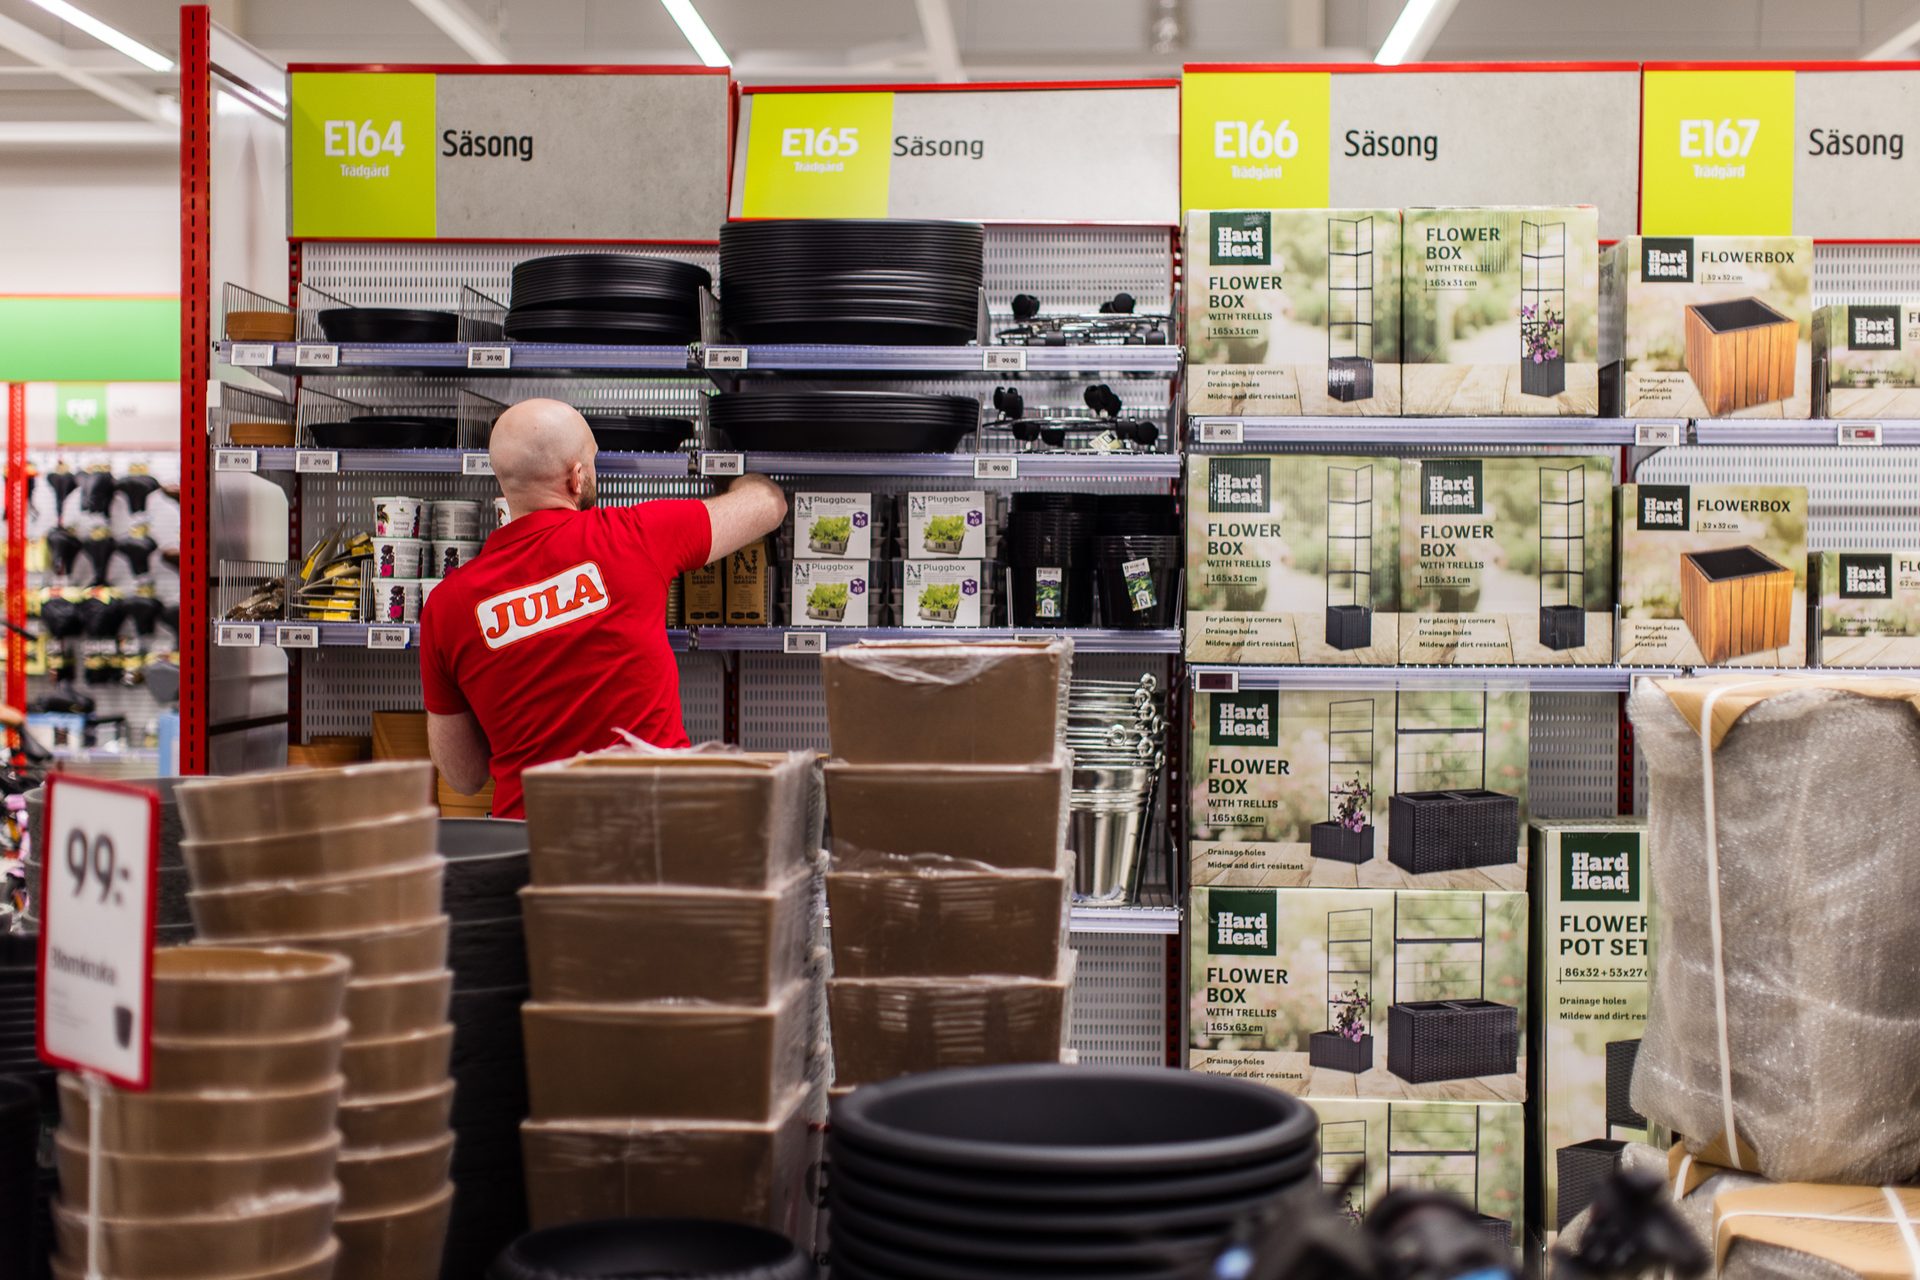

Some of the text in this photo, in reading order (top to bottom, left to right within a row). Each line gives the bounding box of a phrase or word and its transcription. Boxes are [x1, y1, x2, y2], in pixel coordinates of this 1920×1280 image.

[324, 120, 405, 157] E164
[442, 129, 533, 161] Säsong
[781, 127, 859, 157] E165
[1214, 120, 1299, 159] E166
[1344, 129, 1438, 161] Säsong
[1679, 119, 1760, 158] E167
[1808, 129, 1904, 160] Säsong
[893, 135, 984, 160] Säsong
[340, 163, 390, 179] Trädgård
[794, 160, 844, 174] Trädgård
[1231, 165, 1282, 181] Trädgård
[1693, 164, 1745, 180] Trädgård
[1218, 227, 1263, 242] Hard
[1426, 227, 1500, 241] FLOWER
[1218, 242, 1263, 257] Head
[1426, 246, 1462, 260] BOX
[1648, 250, 1687, 263] Hard
[1701, 251, 1795, 264] FLOWERBOX
[1425, 264, 1451, 272] WITH
[1648, 263, 1687, 276] Head
[1209, 276, 1283, 290] FLOWER
[1209, 294, 1245, 308] BOX
[1236, 312, 1273, 320] TRELLIS
[1855, 317, 1894, 331] Hard
[1855, 331, 1894, 344] Head
[1220, 369, 1247, 377] placing
[1217, 474, 1262, 488] Hard
[1429, 476, 1474, 491] Hard
[813, 496, 856, 505] Pluggbox
[927, 495, 970, 504] Pluggbox
[1217, 488, 1262, 504] Head
[1429, 491, 1474, 506] Head
[1645, 498, 1683, 511] Hard
[1697, 500, 1791, 512] FLOWERBOX
[1645, 511, 1683, 524] Head
[1208, 523, 1281, 537] FLOWER
[1421, 525, 1494, 539] FLOWER
[1208, 541, 1243, 555] BOX
[1421, 543, 1456, 557] BOX
[811, 563, 854, 571] Pluggbox
[923, 563, 966, 572] Pluggbox
[1207, 560, 1271, 568] WITH TRELLIS
[1420, 561, 1484, 569] WITH TRELLIS
[1846, 566, 1886, 579] Hard
[1846, 579, 1886, 592] Head
[486, 573, 604, 639] JULA
[1219, 616, 1245, 624] placing
[1432, 618, 1458, 626] placing
[1205, 628, 1238, 636] Drainage
[1220, 703, 1269, 720] Hard
[1220, 720, 1269, 736] Head
[1208, 758, 1290, 775] FLOWER
[1208, 779, 1248, 794] BOX
[1207, 799, 1279, 809] WITH TRELLIS
[1207, 848, 1266, 857] Drainage holes
[1250, 862, 1266, 870] dirt
[1572, 852, 1629, 871] Hard
[1572, 871, 1629, 890] Head
[1218, 912, 1268, 929] Hard
[1218, 929, 1268, 945] Head
[1560, 939, 1604, 956] POT
[1207, 967, 1288, 984] FLOWER
[1565, 968, 1599, 977] 86x32
[1609, 968, 1643, 977] 53x27
[1207, 988, 1246, 1004] BOX
[1559, 997, 1627, 1007] Drainage holes
[1206, 1008, 1277, 1018] WITH TRELLIS
[1559, 1012, 1592, 1020] Mildew
[1593, 1012, 1610, 1020] and
[1612, 1012, 1629, 1020] dirt
[1206, 1057, 1242, 1066] Drainage
[1248, 1071, 1264, 1079] dirt
